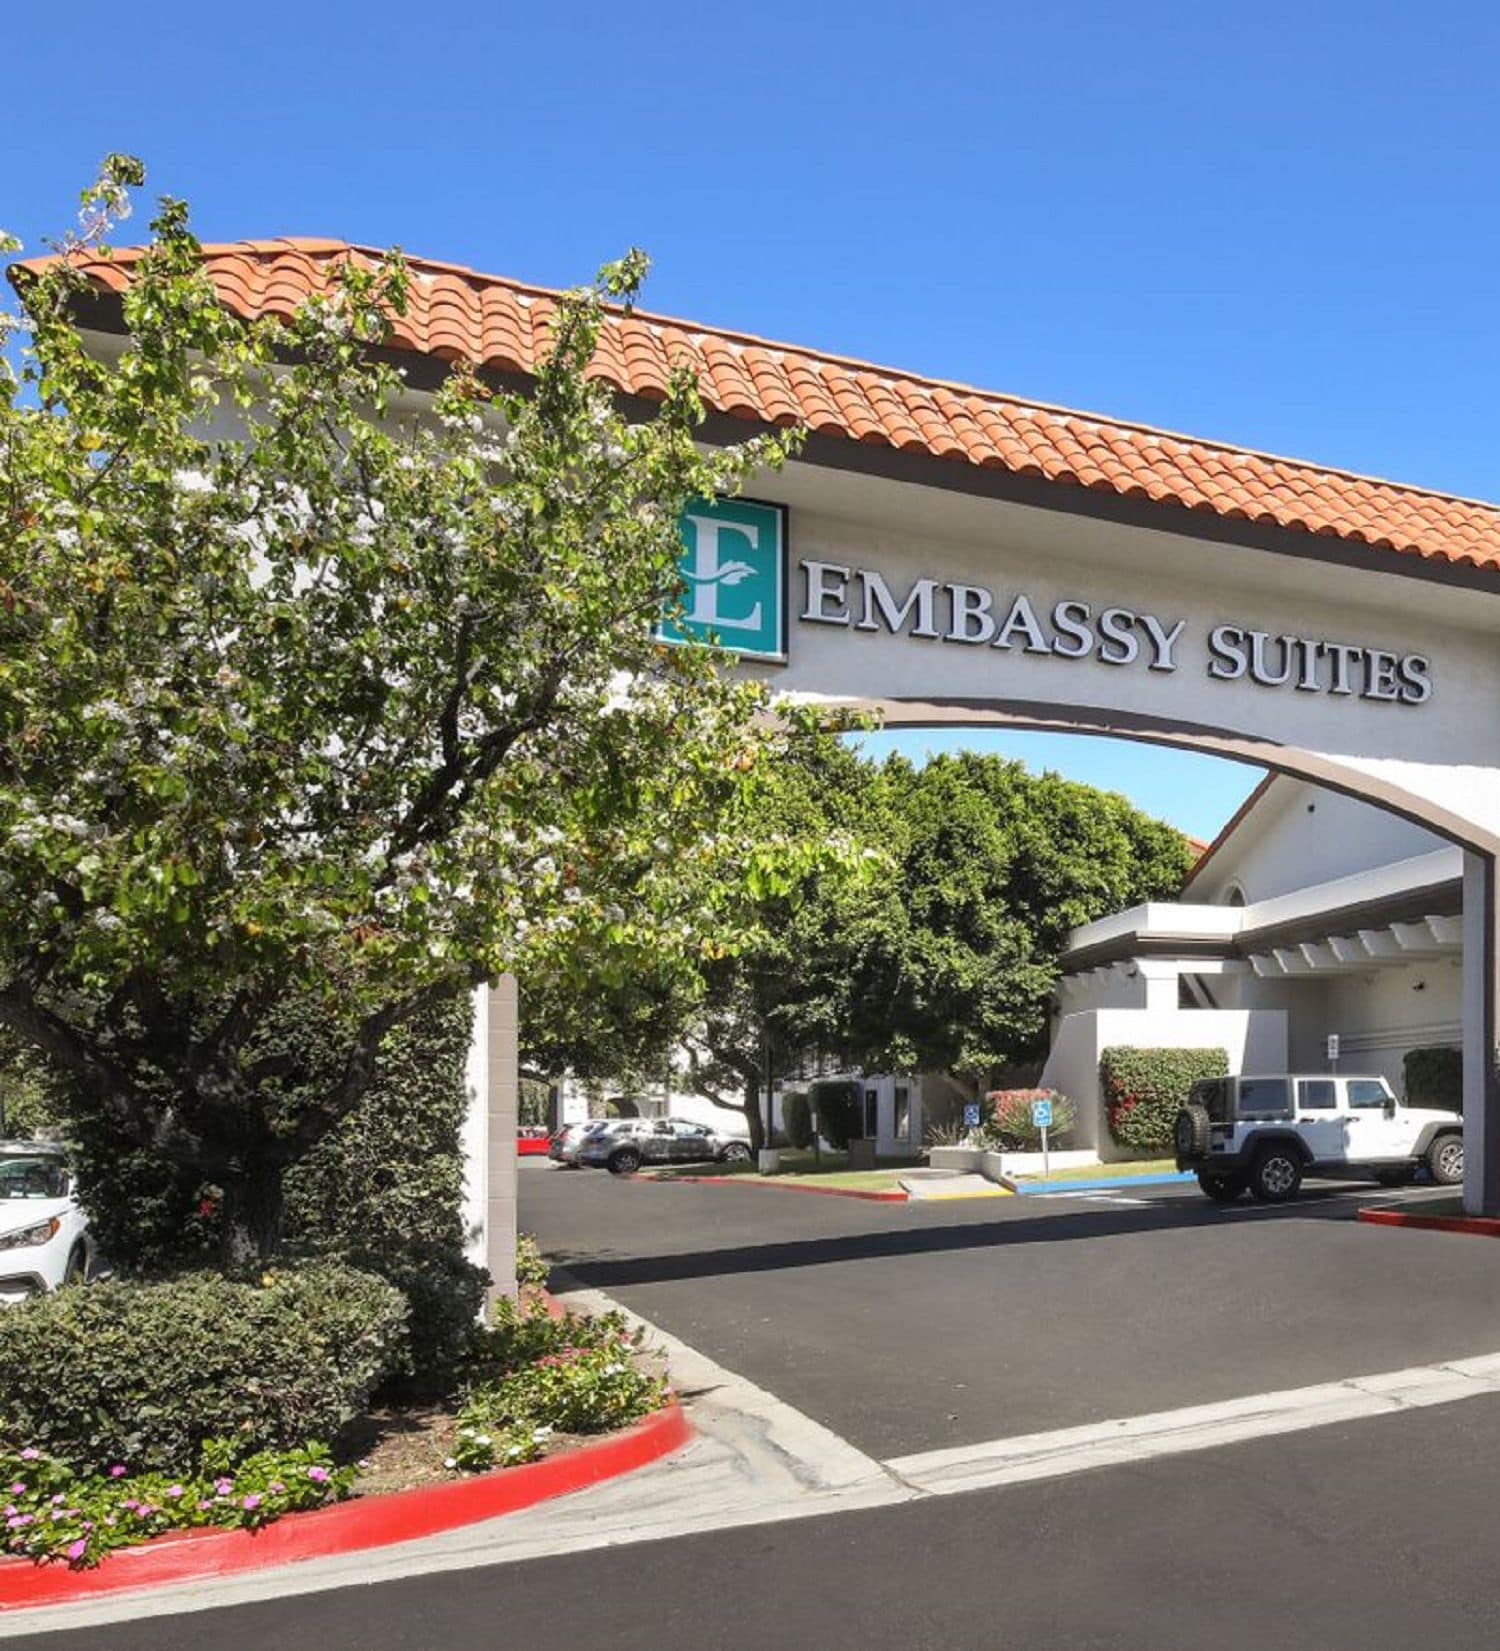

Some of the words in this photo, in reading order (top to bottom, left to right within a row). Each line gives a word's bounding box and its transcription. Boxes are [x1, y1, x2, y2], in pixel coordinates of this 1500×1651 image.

[683, 514, 762, 631] E
[800, 560, 1187, 672] EMBASSY
[1208, 625, 1434, 705] SUITES
